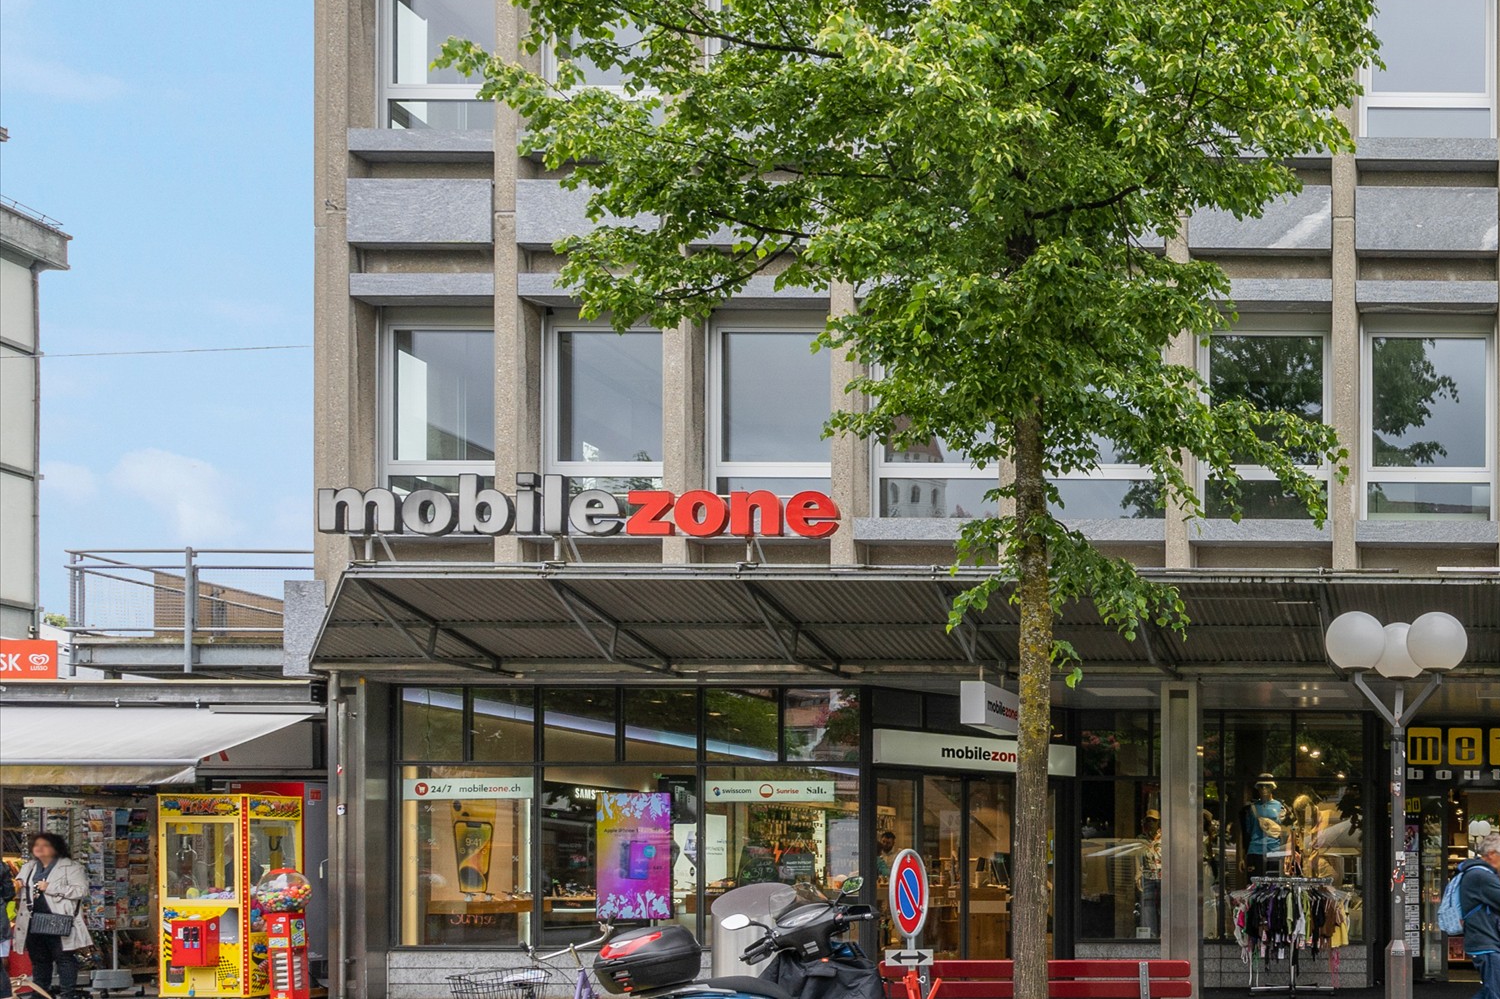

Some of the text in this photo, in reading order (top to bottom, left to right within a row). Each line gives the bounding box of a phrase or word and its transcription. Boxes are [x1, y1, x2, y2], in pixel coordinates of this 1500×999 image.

[318, 472, 842, 538] mobilezone
[987, 699, 1018, 721] mobilezone
[941, 746, 1017, 763] mobilezon
[430, 784, 521, 793] 24/7 mobilezone.ch
[575, 787, 609, 800] SAMS
[806, 786, 827, 795] Salt.
